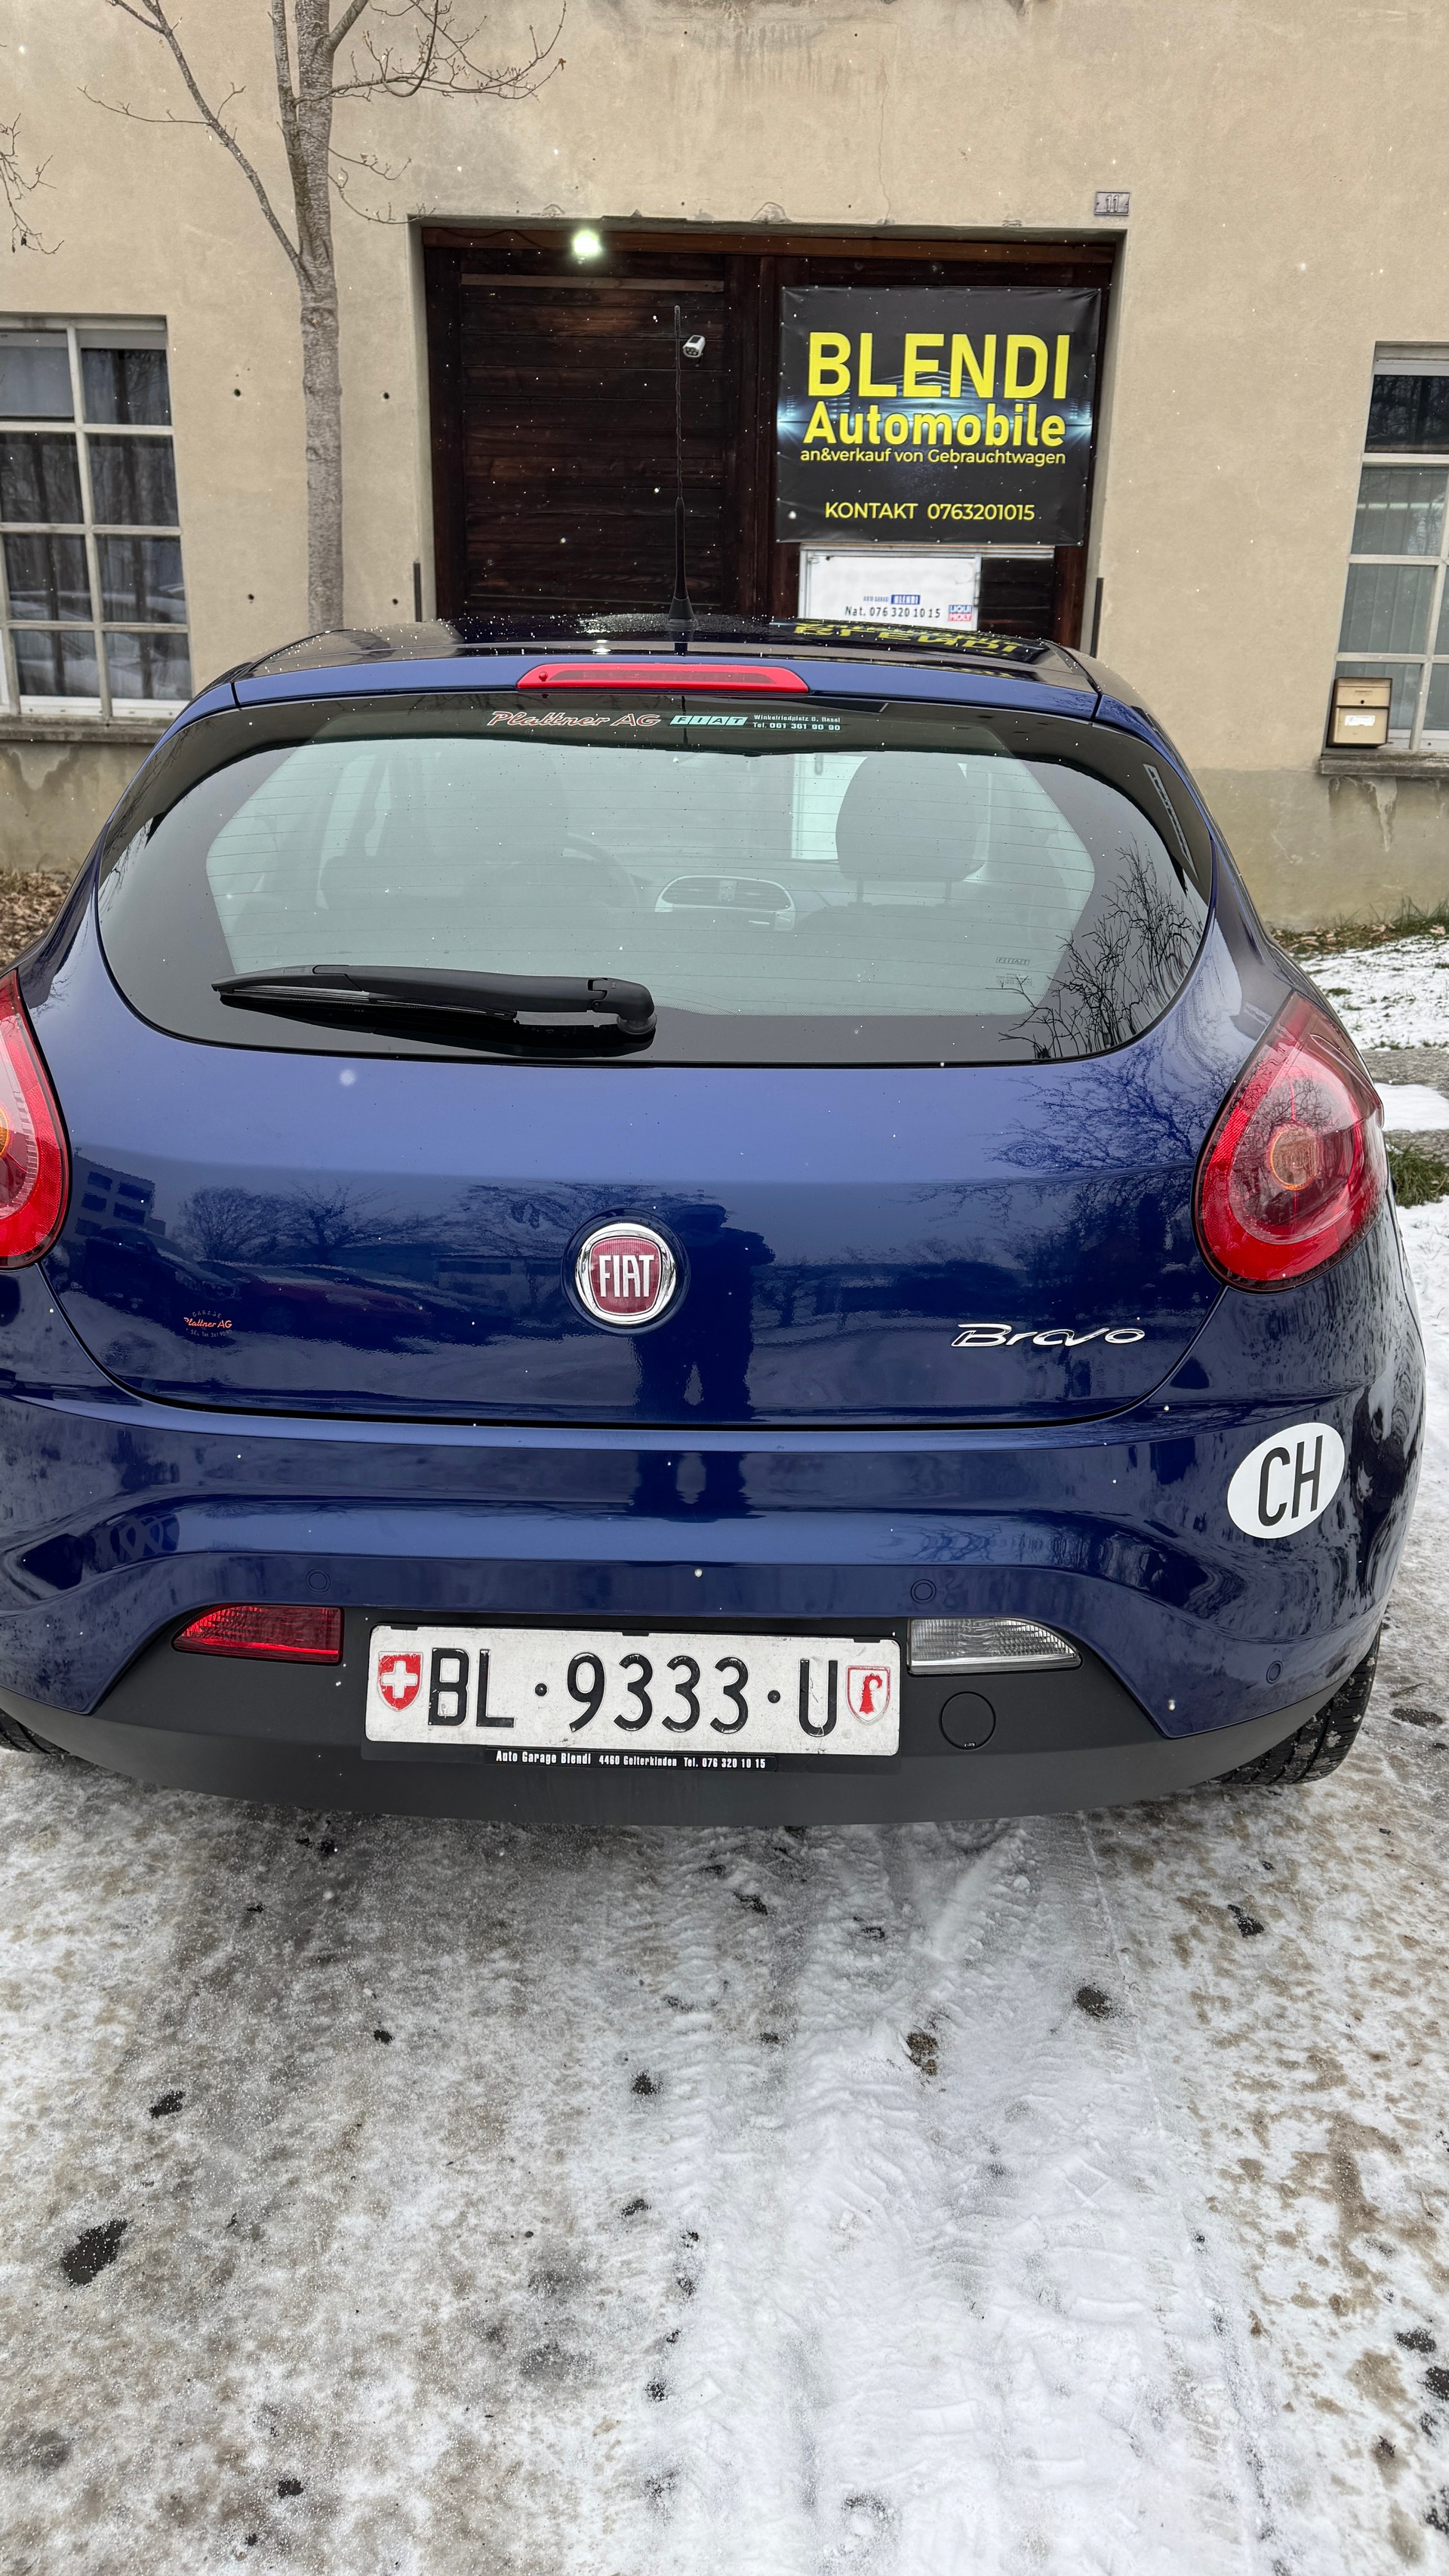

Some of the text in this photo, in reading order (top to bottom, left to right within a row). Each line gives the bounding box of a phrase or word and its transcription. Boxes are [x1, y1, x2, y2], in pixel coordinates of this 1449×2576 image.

[1106, 195, 1119, 212] 11
[808, 332, 1070, 399] BLENDI
[803, 401, 1066, 446] Automobile
[800, 448, 1066, 467] an&verkauf von Gebrauchtwagen
[825, 503, 1035, 521] KONTAKT 0763201015
[844, 605, 941, 618] Nat. 076 320 10 15
[487, 711, 662, 727] Plattner AG
[670, 716, 749, 726] FIAT
[598, 1254, 655, 1297] FIAT
[217, 1319, 232, 1328] AG
[951, 1323, 1145, 1347] Bravo
[1257, 1434, 1324, 1526] CH
[496, 1750, 766, 1768] Auto Garage Blendi 4460 Gelterkinden Tel. 076 320 10 15
